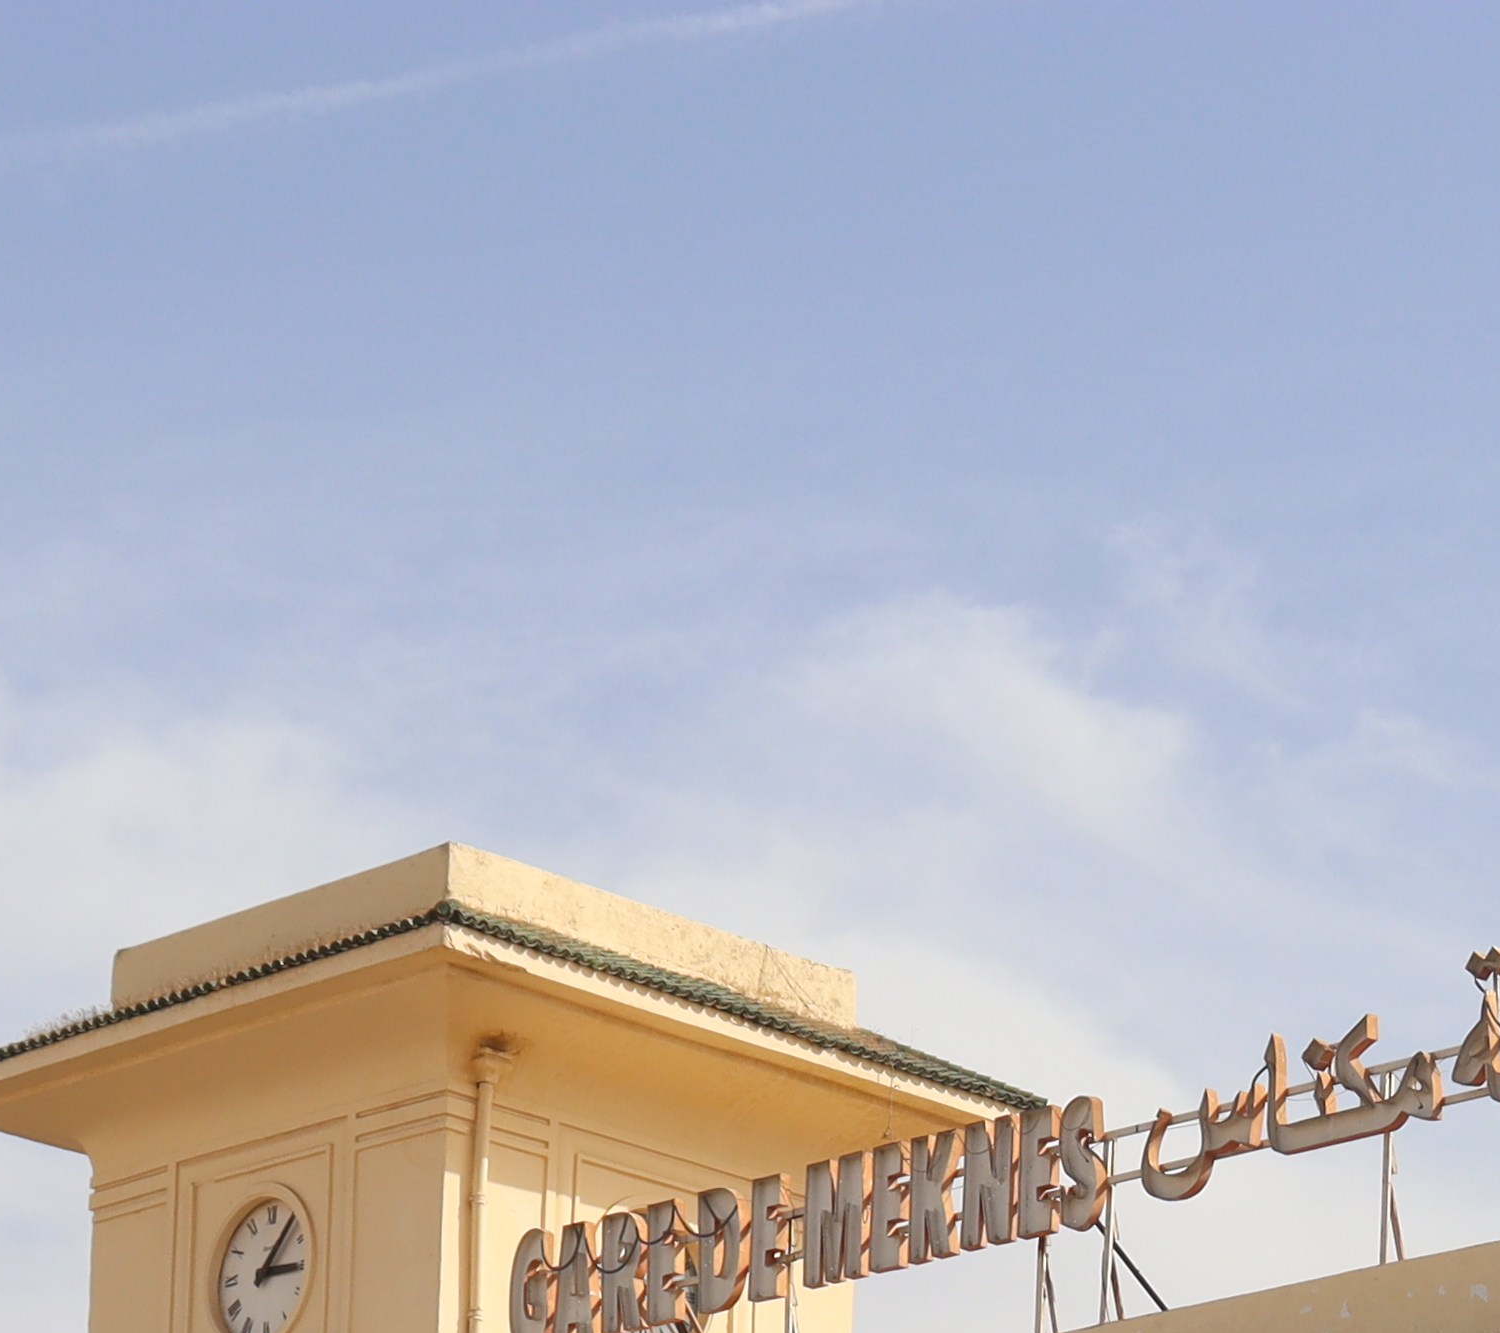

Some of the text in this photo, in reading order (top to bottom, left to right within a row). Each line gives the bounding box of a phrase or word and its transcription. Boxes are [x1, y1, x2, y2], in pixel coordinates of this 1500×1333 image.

[698, 1172, 790, 1314] DE
[802, 1095, 1108, 1289] MEKNES
[1141, 1013, 1443, 1201] مكناس
